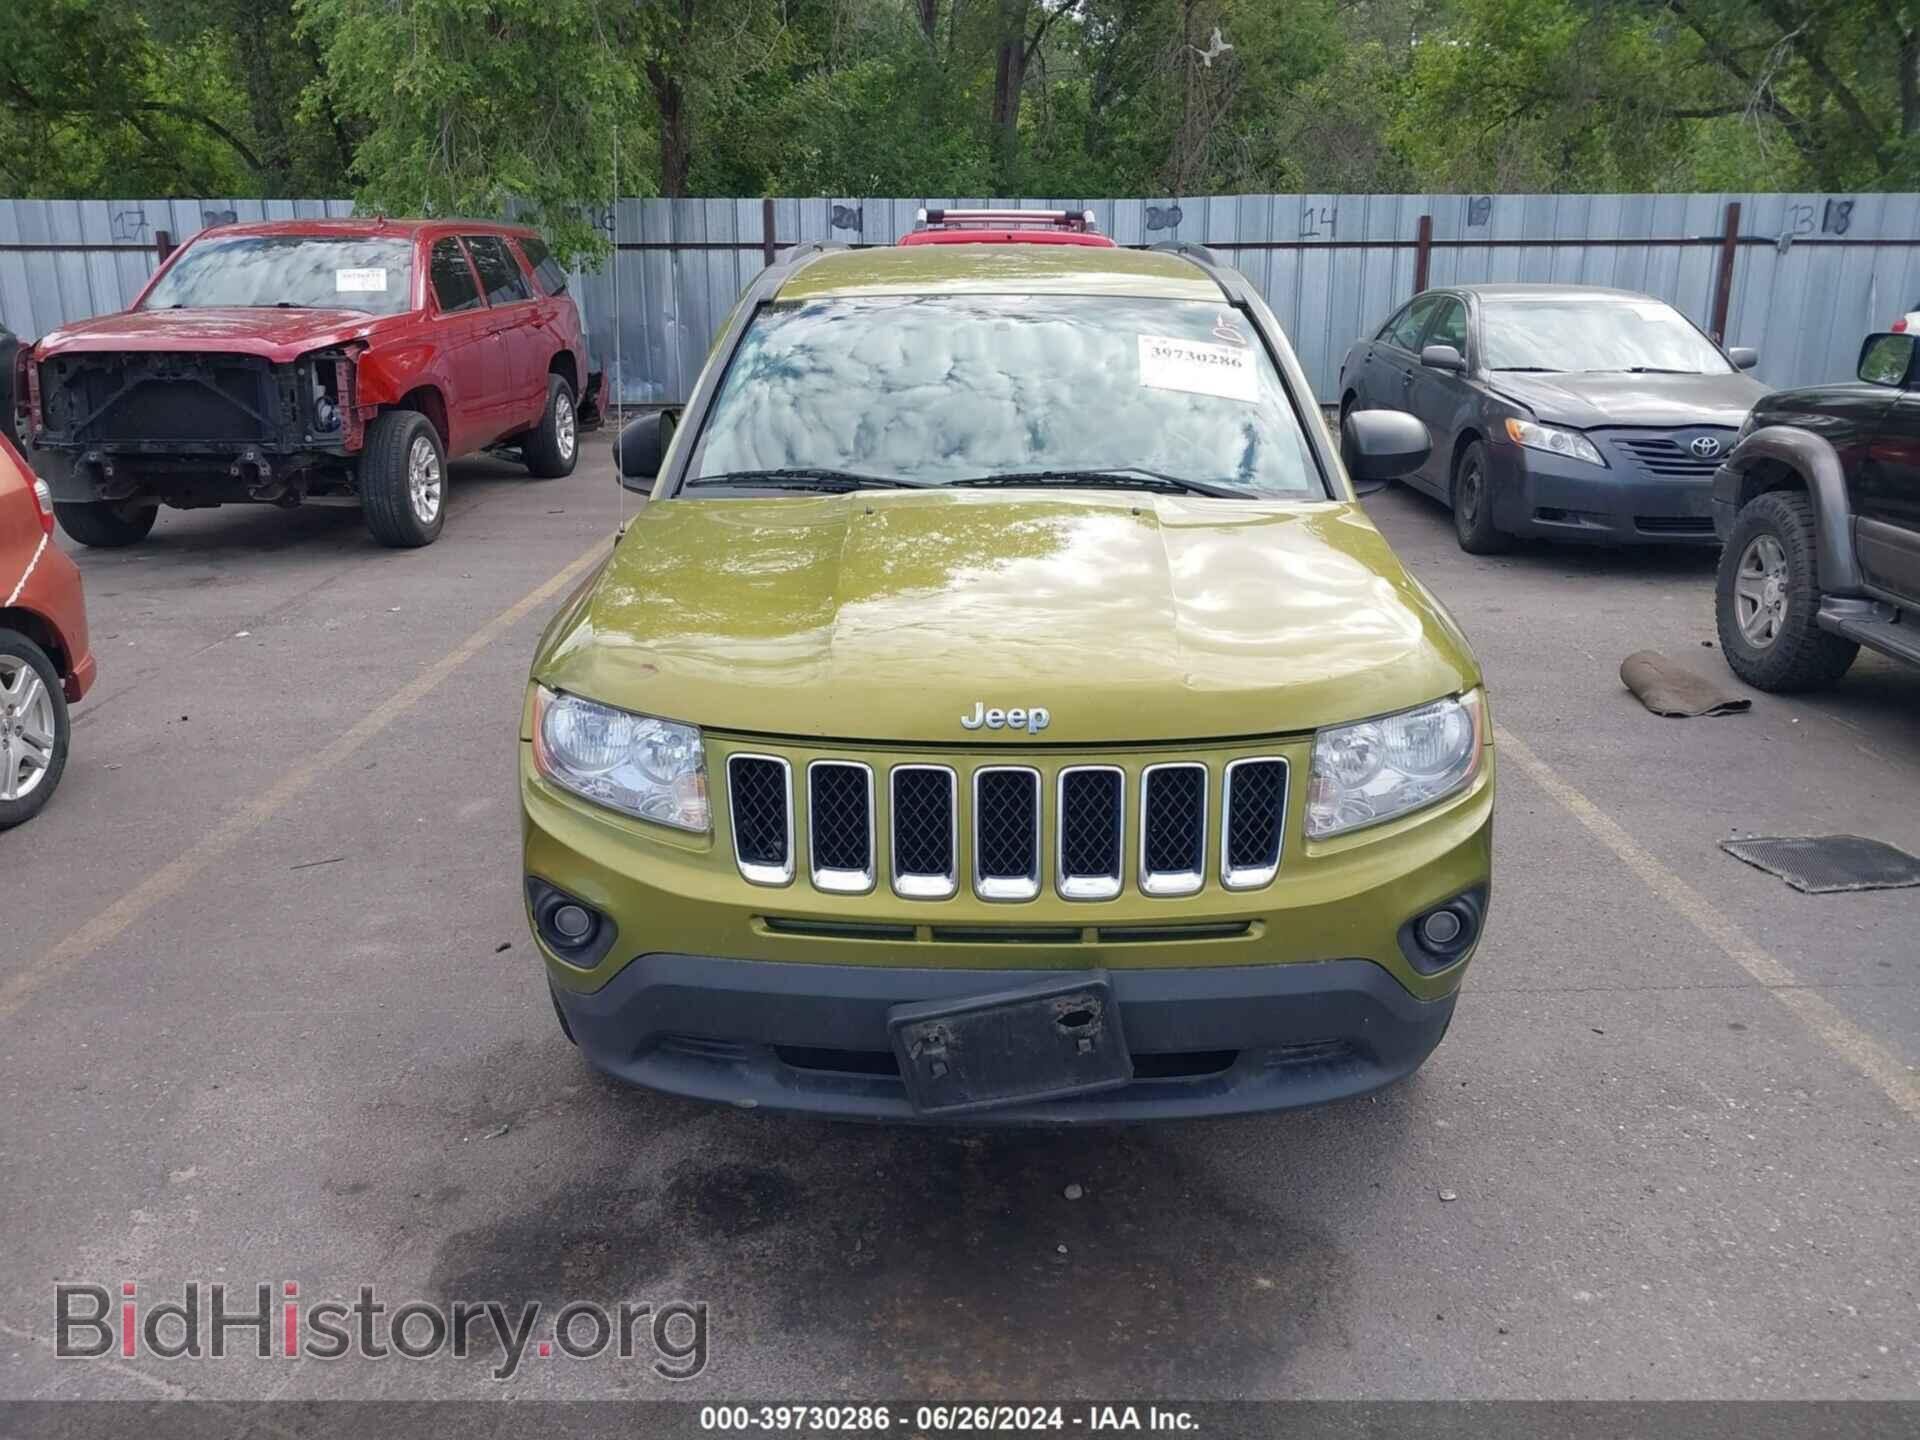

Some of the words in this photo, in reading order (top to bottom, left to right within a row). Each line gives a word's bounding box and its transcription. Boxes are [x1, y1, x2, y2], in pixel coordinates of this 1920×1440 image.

[113, 209, 150, 241] 17
[1299, 207, 1338, 238] 14
[1151, 346, 1243, 368] 39730286
[960, 701, 1050, 735] Jeep
